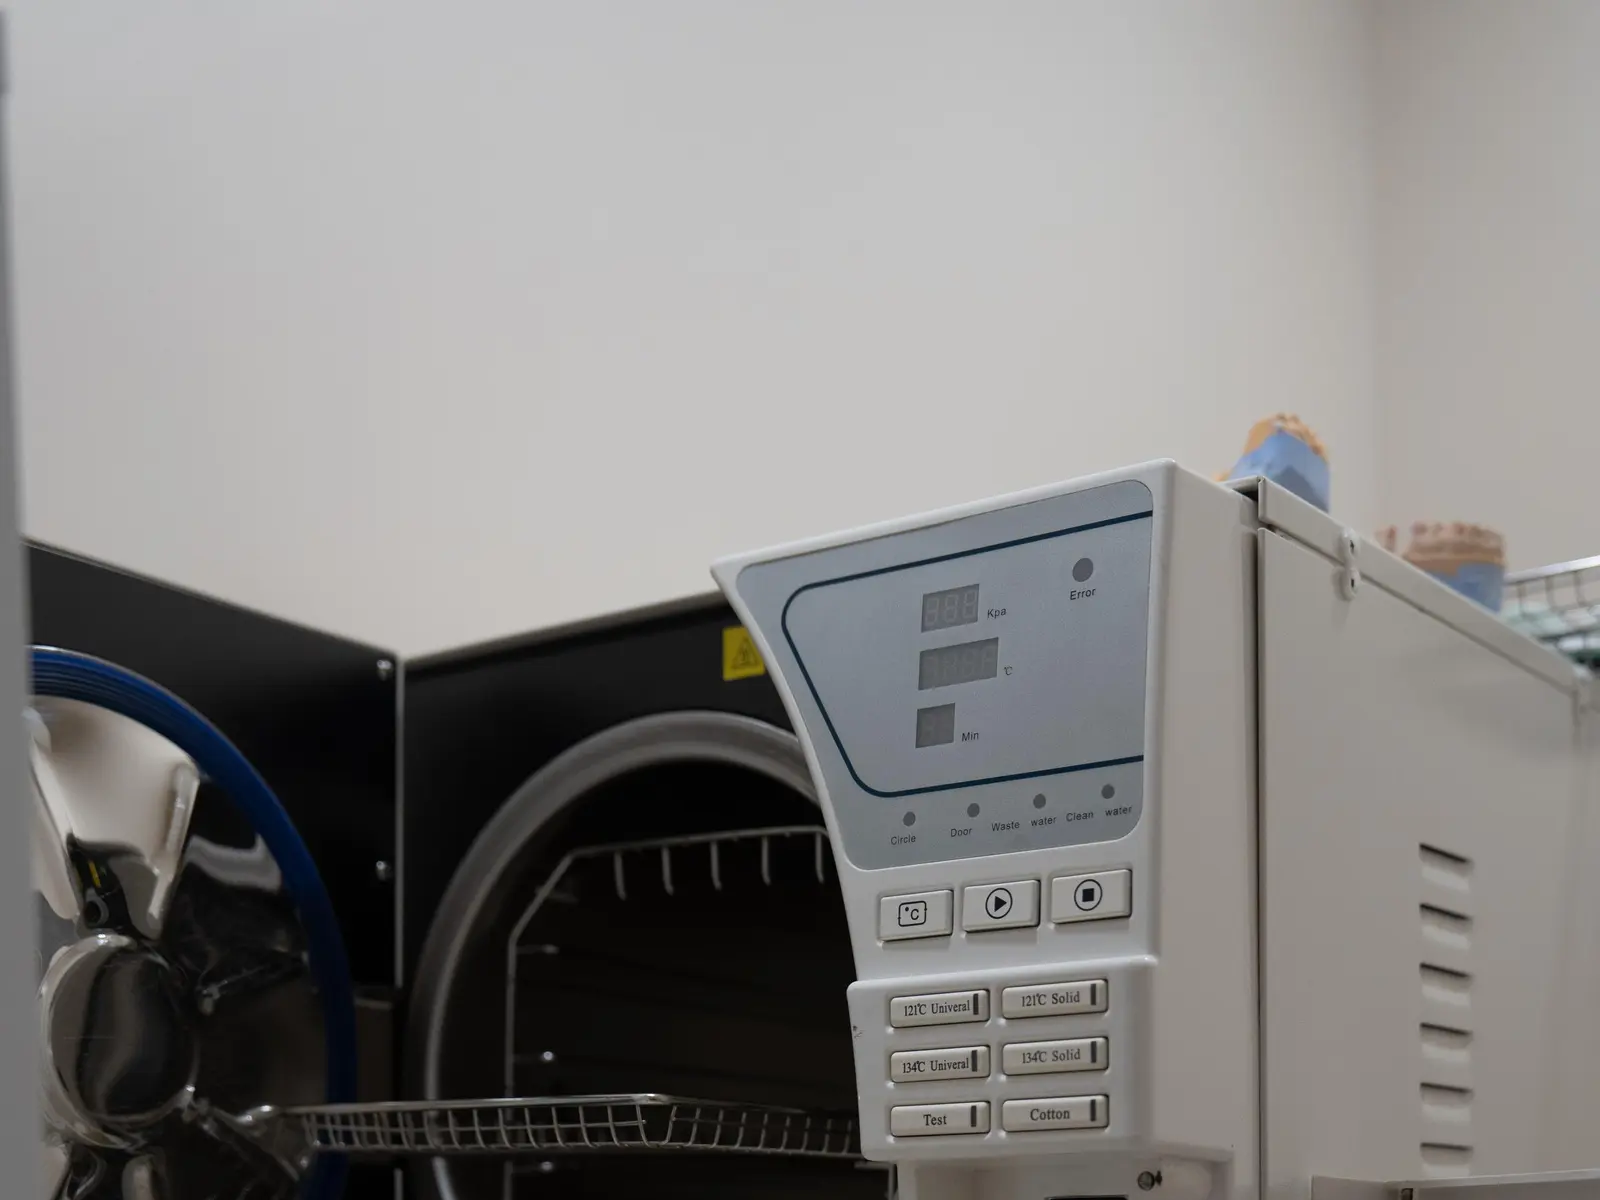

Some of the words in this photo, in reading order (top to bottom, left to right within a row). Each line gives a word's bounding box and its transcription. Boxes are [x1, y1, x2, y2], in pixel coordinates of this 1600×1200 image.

[1070, 587, 1096, 600] Error
[987, 607, 1007, 619] Kpa
[961, 731, 980, 742] Min
[1065, 810, 1094, 822] Clean
[1105, 805, 1133, 816] water
[991, 820, 1021, 832] Waste
[1030, 816, 1057, 827] water
[950, 826, 973, 838] Door
[890, 834, 916, 845] Circle
[1051, 991, 1081, 1005] Solid
[931, 1000, 971, 1014] Univeral
[1051, 1048, 1081, 1062] Solid
[930, 1057, 970, 1071] Univeral
[924, 1114, 947, 1126] Test
[1030, 1108, 1071, 1121] Cotton
